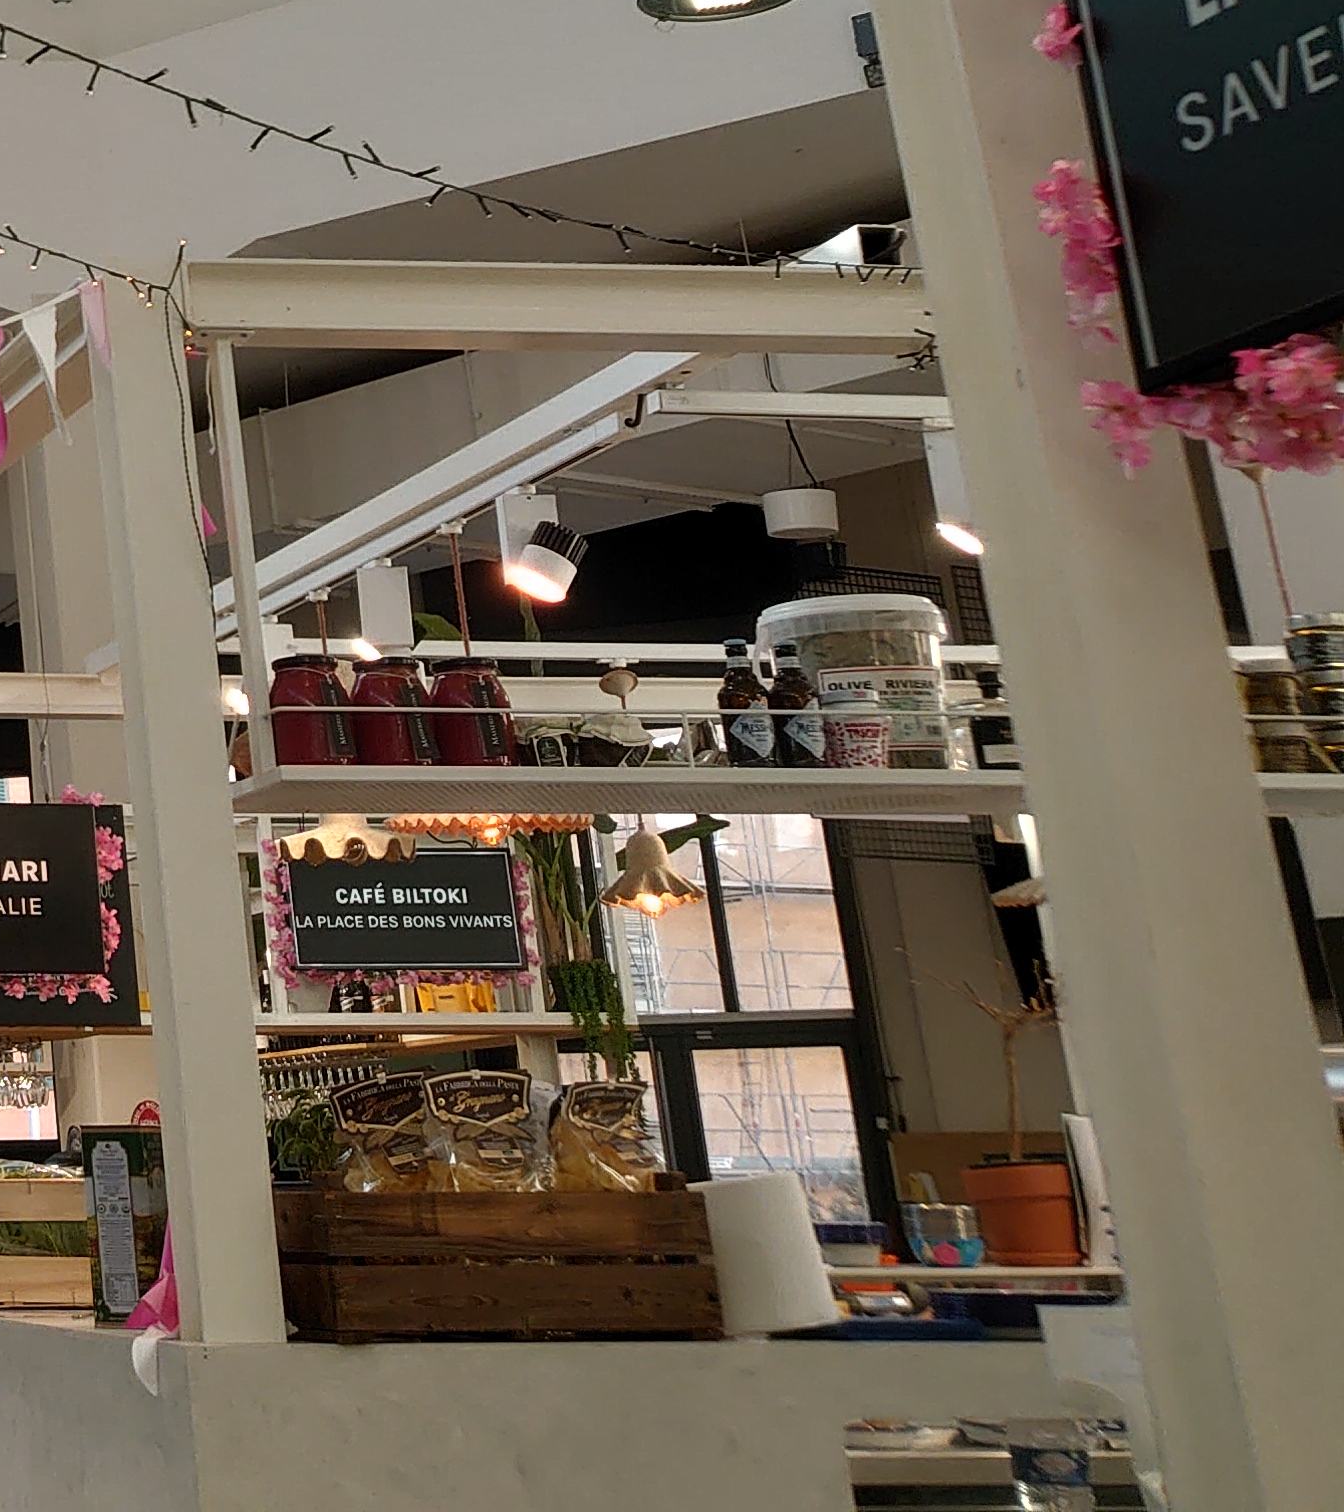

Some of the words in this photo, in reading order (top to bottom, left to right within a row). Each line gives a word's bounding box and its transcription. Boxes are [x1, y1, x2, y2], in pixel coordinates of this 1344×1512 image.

[1175, 13, 1344, 152] SAVE
[827, 679, 872, 692] OLIVE
[335, 882, 386, 904] CAFÉ
[392, 887, 468, 904] BILTOKI
[295, 915, 313, 929] LA
[317, 915, 364, 929] PLACE
[368, 915, 399, 929] DES
[403, 915, 446, 929] BONS
[448, 915, 513, 929] VIVANTS
